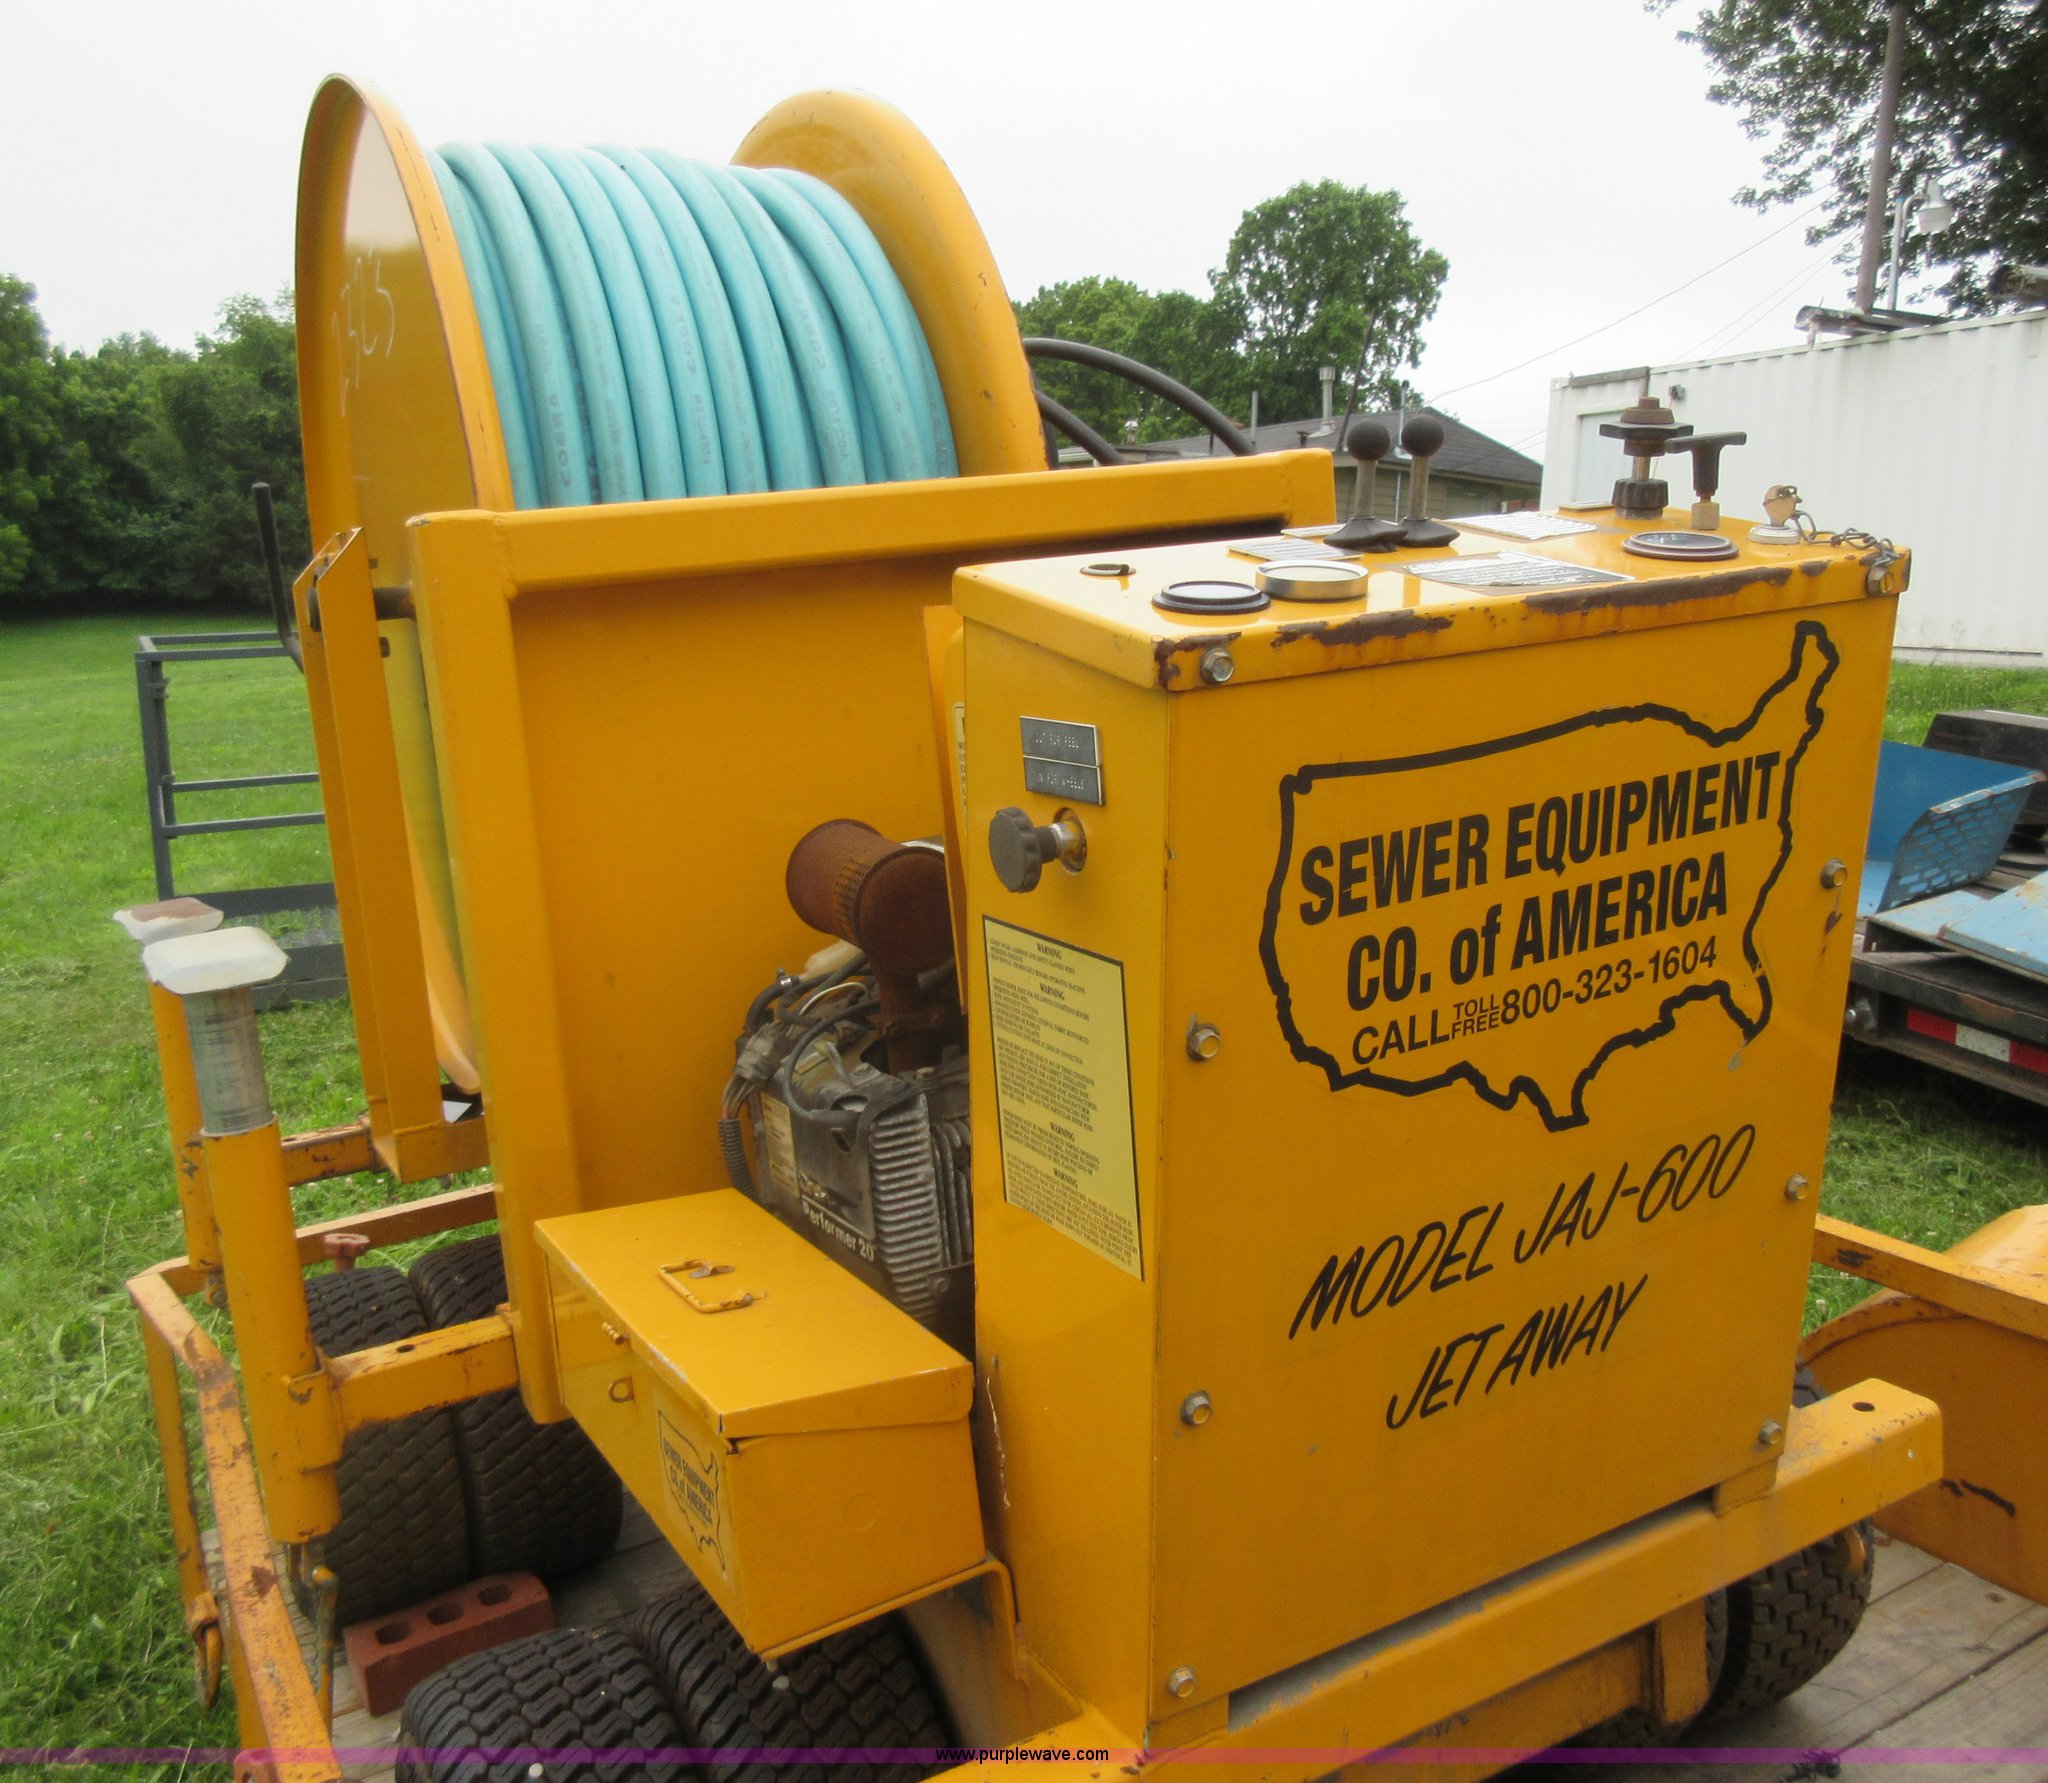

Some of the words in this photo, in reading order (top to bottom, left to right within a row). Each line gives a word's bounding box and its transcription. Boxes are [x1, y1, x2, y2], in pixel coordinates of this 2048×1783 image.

[1300, 814, 1490, 926] SEWER
[1505, 752, 1781, 879] EQUIPMENT
[1348, 927, 1432, 1012] CO.
[1450, 904, 1502, 986] of
[1511, 852, 1728, 970] AMERICA
[1454, 994, 1499, 1020] TOLL
[1501, 936, 1718, 1025] 800-323-1604
[1352, 1010, 1450, 1065] CALL
[1452, 1011, 1499, 1040] FREE
[802, 1200, 857, 1250] Performer
[1289, 1202, 1505, 1340] MODEL
[1513, 1124, 1756, 1264] JAJ-600
[682, 1459, 715, 1508] EQUIPMENT
